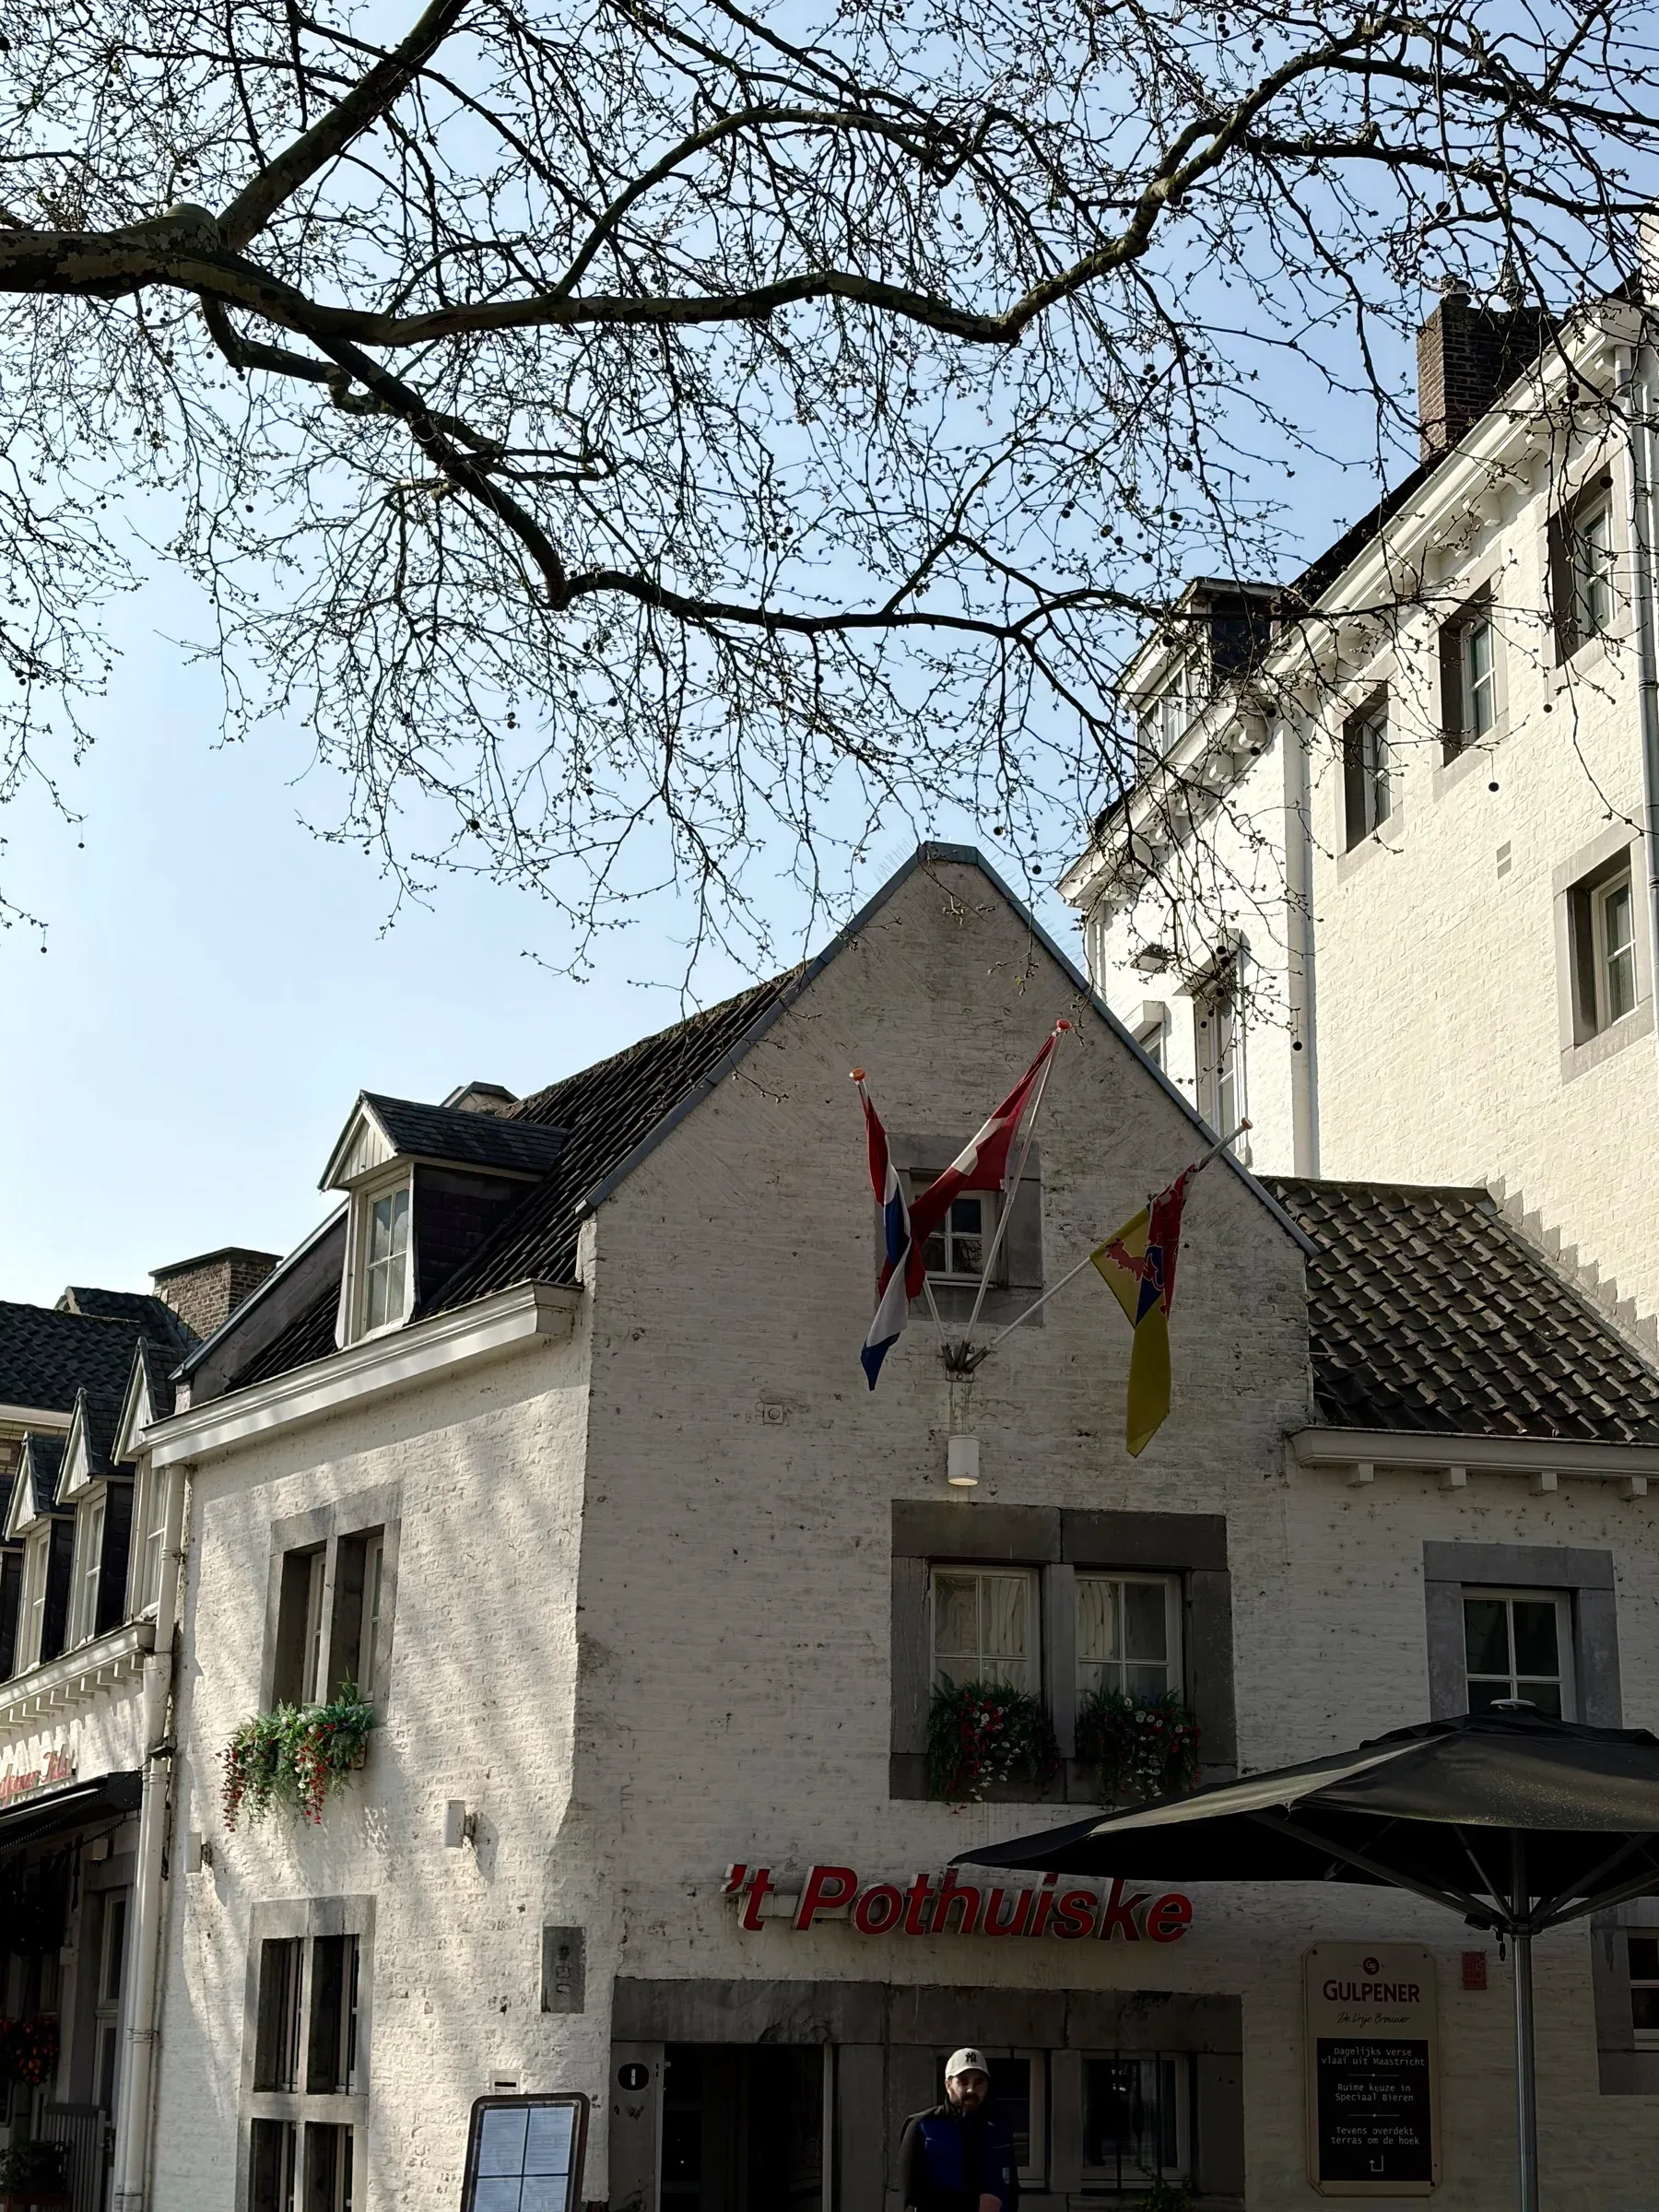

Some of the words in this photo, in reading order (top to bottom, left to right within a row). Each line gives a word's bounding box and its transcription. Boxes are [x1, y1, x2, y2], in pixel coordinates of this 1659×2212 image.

[720, 1863, 775, 1932] 't
[794, 1865, 1194, 1943] Pothuiske
[1323, 1979, 1420, 2004] GULPENER
[1337, 2011, 1351, 2024] De
[1374, 2012, 1410, 2025] Brouwer
[1333, 2046, 1382, 2058] Dagelijks
[1385, 2049, 1412, 2057] verse
[1321, 2055, 1347, 2065] vlaai
[1352, 2057, 1369, 2065] uit
[1372, 2056, 1426, 2066] Maastricht
[1337, 2082, 1364, 2092] Ruime
[1369, 2083, 1395, 2092] keuze
[1400, 2083, 1411, 2092] in
[1335, 2092, 1376, 2102] Speciaal
[1382, 2093, 1414, 2102] Bieren
[1335, 2126, 1368, 2136] Tevens
[1371, 2125, 1414, 2136] overdekt
[1331, 2136, 1362, 2145] terras
[1367, 2136, 1379, 2145] om
[1382, 2136, 1394, 2145] de
[1398, 2136, 1420, 2146] hoek
